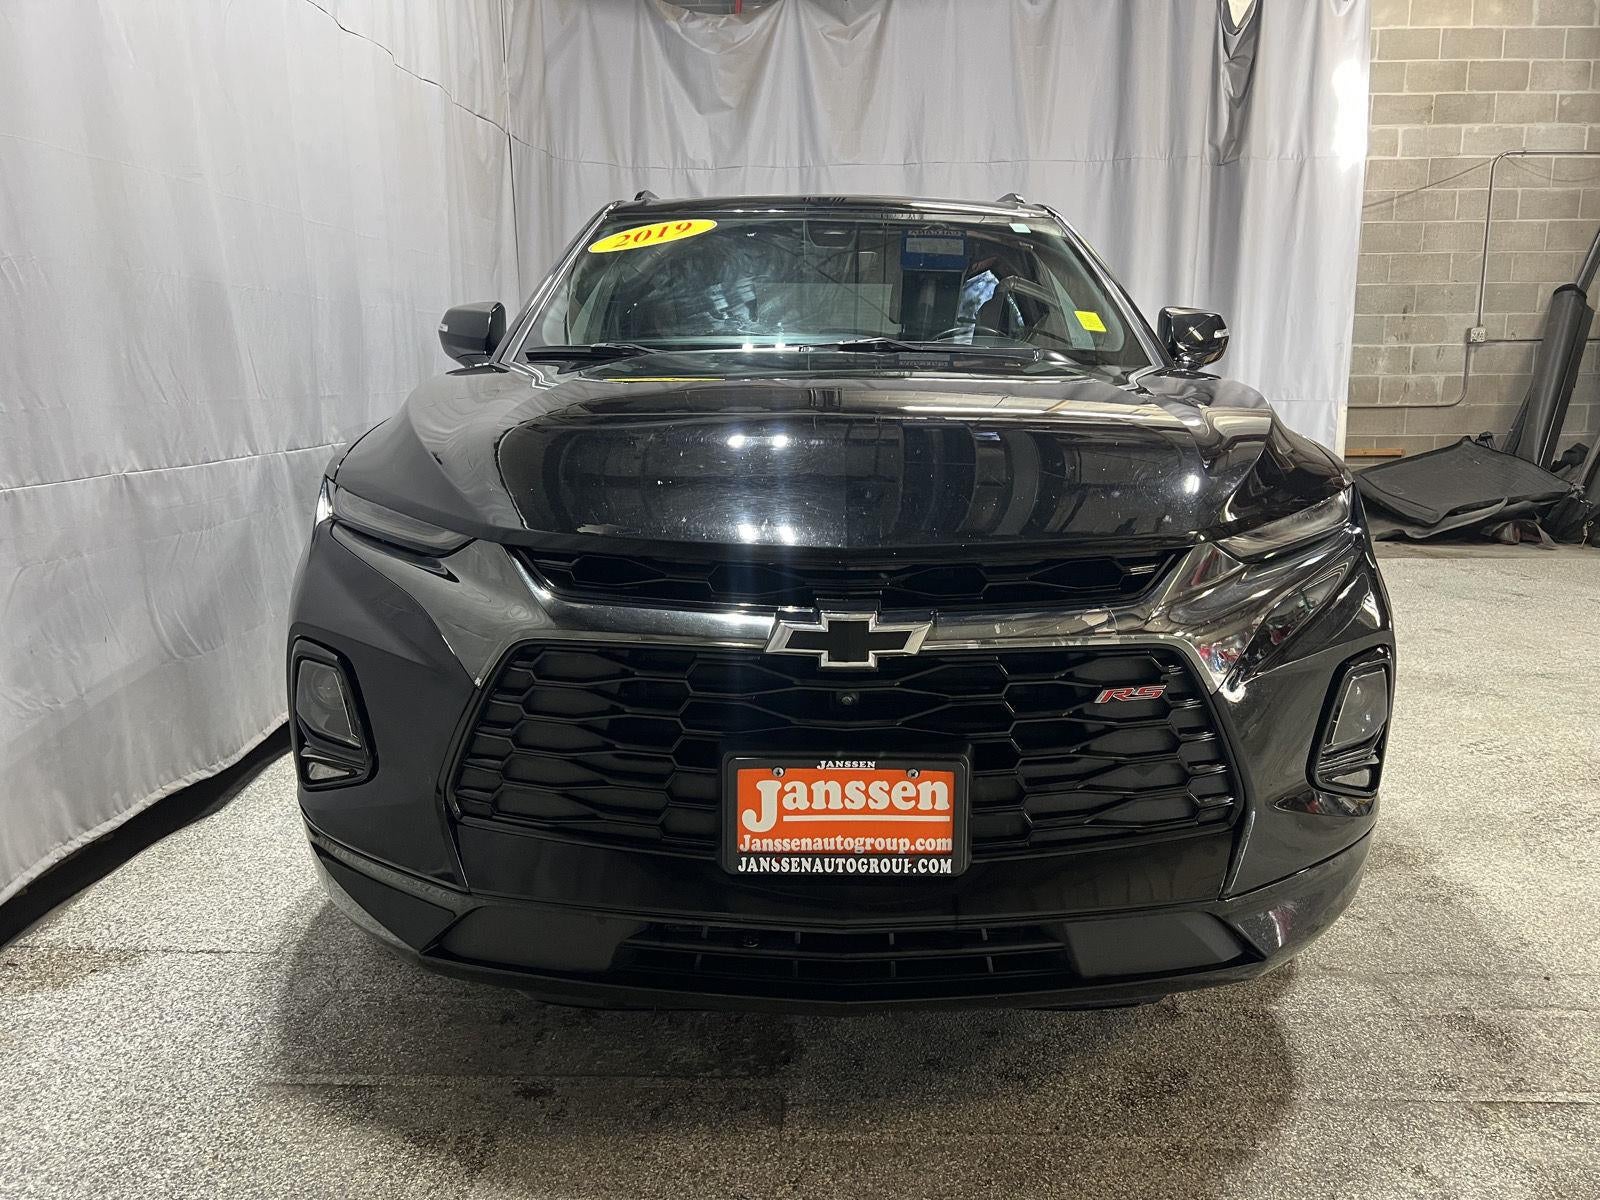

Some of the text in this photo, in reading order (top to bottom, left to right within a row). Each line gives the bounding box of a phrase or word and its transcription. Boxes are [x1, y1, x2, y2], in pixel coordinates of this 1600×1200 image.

[612, 222, 692, 248] 2019
[1094, 685, 1166, 703] RS
[817, 760, 875, 770] JANSSEN
[741, 779, 950, 832] Janssen
[739, 834, 953, 854] Janssenautogroup.com
